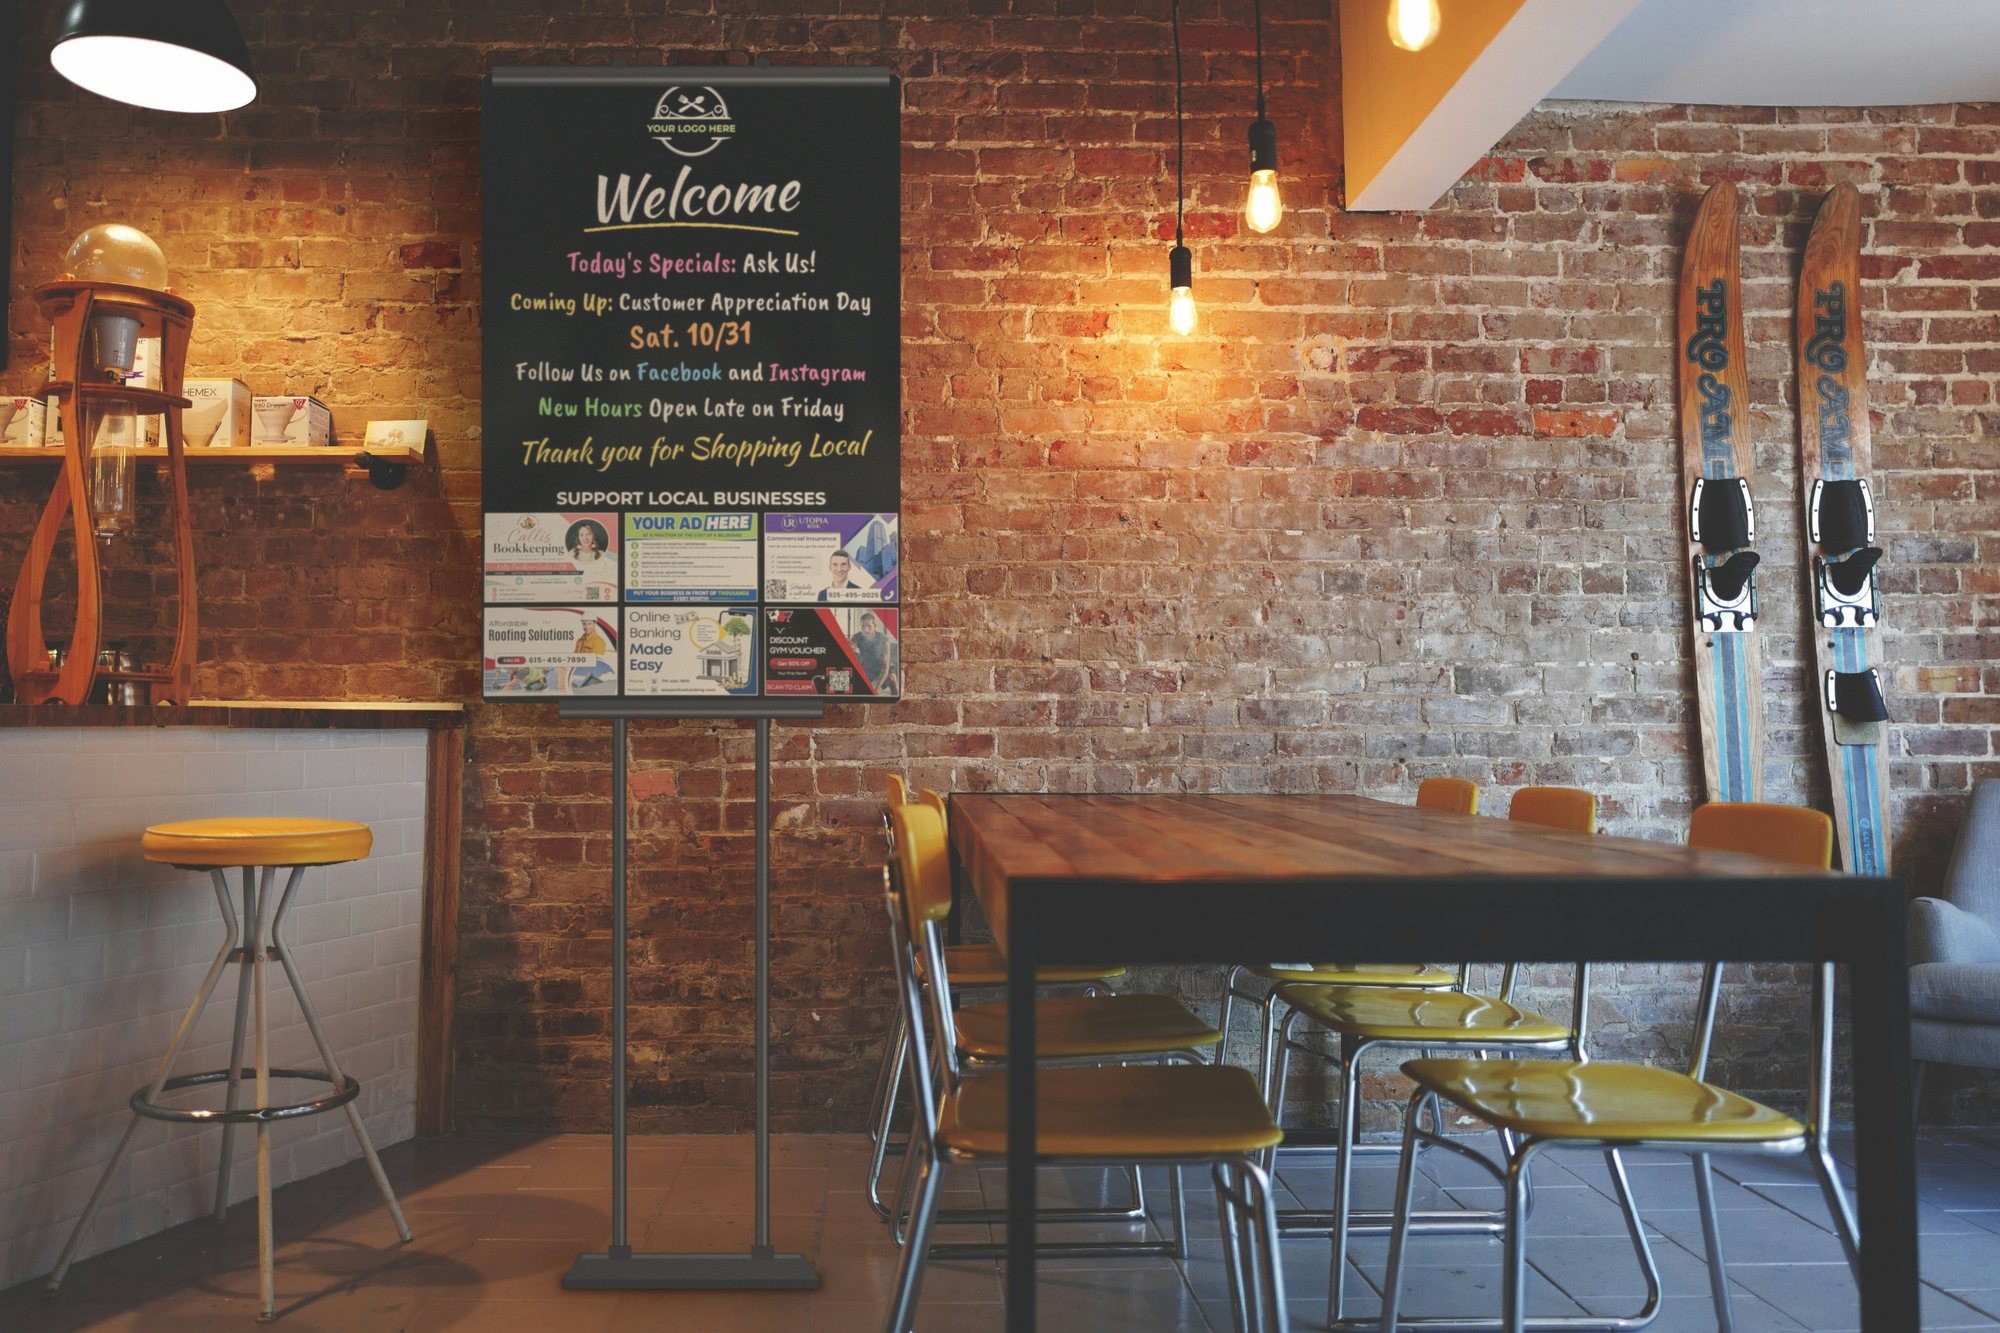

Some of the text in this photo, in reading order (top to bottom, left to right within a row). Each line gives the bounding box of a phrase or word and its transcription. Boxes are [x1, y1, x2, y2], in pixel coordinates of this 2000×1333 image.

[597, 165, 801, 223] Welcome
[567, 250, 815, 279] Today's Specials: Ask Us!
[511, 292, 870, 316] Coming Up: Customer Appreciation Day
[1686, 278, 1729, 372] PRO
[1804, 280, 1848, 374] PRO
[630, 321, 750, 352] Sat. 10/31
[516, 361, 865, 386] Follow Us on Facebook and Instagram
[183, 388, 217, 397] HEMEX
[539, 397, 843, 423] New Hours Open Late on Friday
[523, 430, 873, 472] Thank you for Shopping Local
[557, 491, 826, 505] SUPPORT LOCAL BUSINESSES
[632, 516, 750, 530] YOUR AD HERE
[494, 544, 564, 556] Bookkeeping
[630, 612, 670, 622] Online
[488, 628, 574, 642] Roofing Solutions
[630, 628, 681, 640] Banking
[630, 643, 673, 655] Made
[630, 659, 663, 673] Easy
